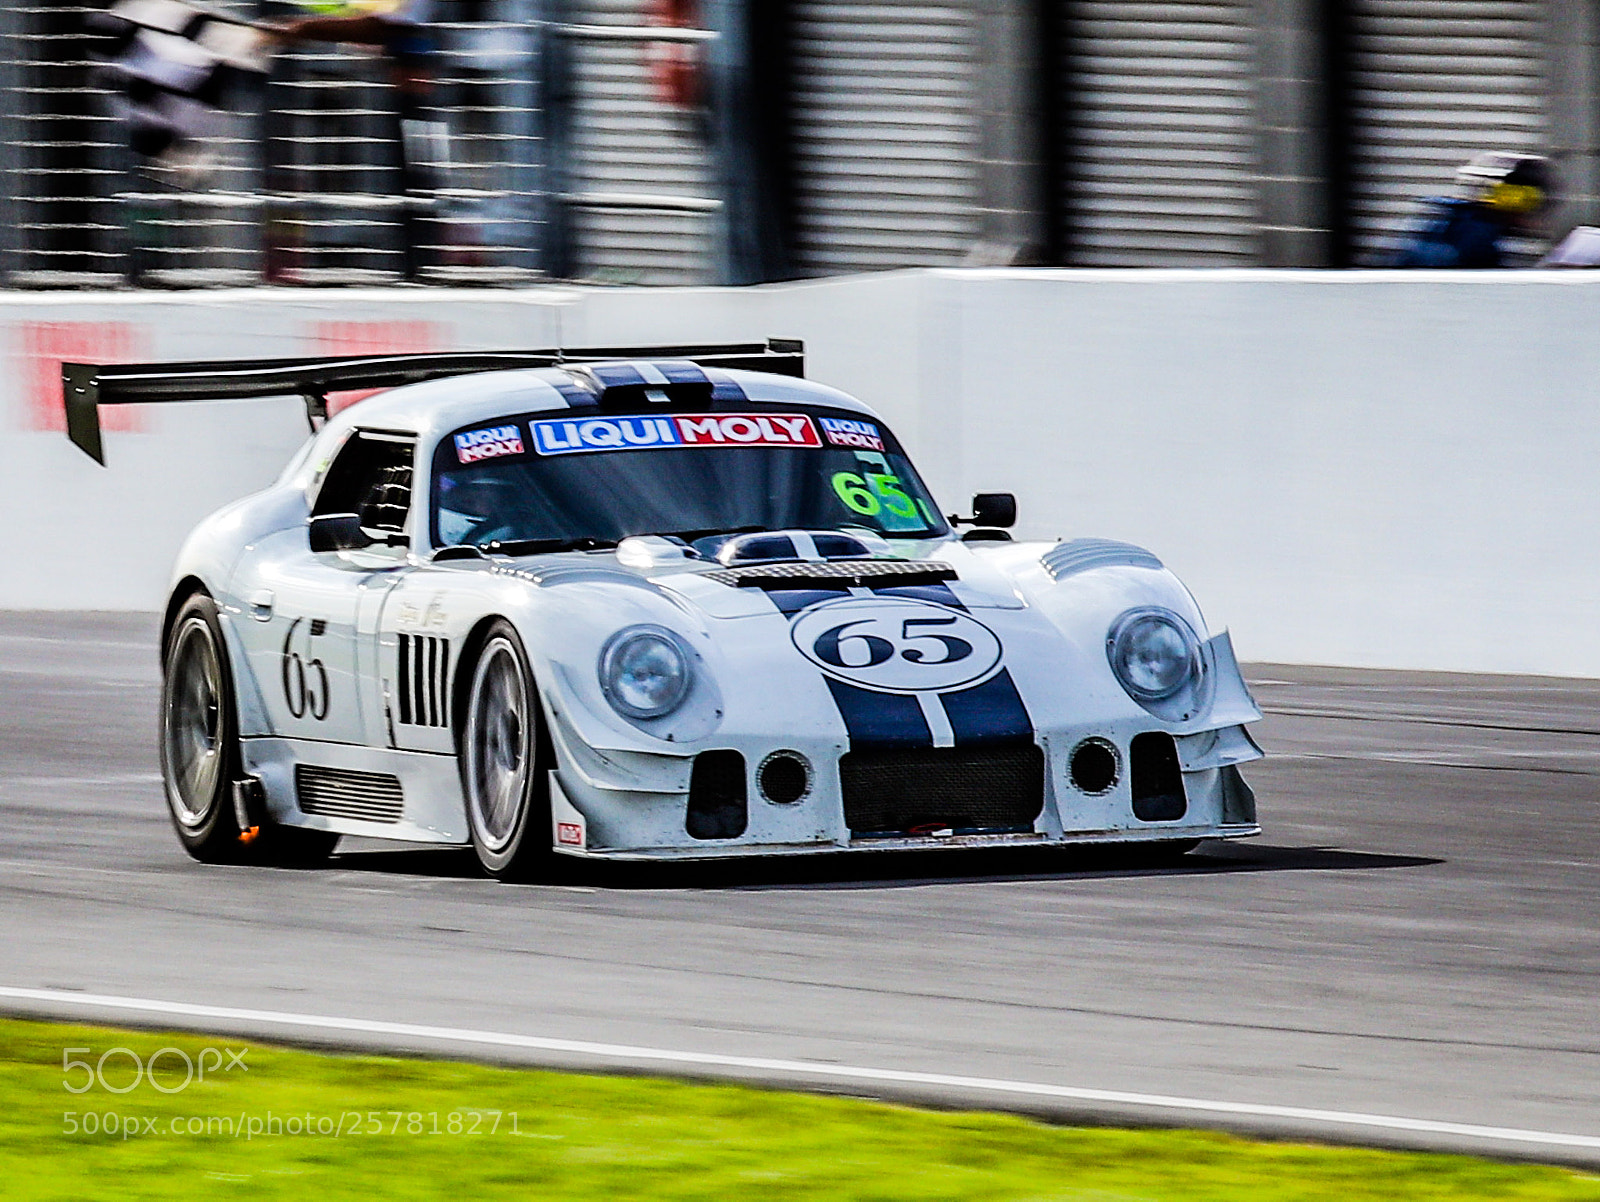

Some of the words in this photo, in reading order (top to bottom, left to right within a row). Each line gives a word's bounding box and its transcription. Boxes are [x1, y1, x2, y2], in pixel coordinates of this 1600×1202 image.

[456, 427, 519, 449] LIQUI
[538, 418, 675, 449] LIQUI
[676, 416, 806, 443] MOLY
[823, 419, 879, 438] LIQUI
[828, 431, 881, 451] MOLY
[461, 440, 522, 462] MOLY
[832, 471, 919, 518] 65
[813, 616, 973, 668] 65
[283, 617, 329, 721] 65
